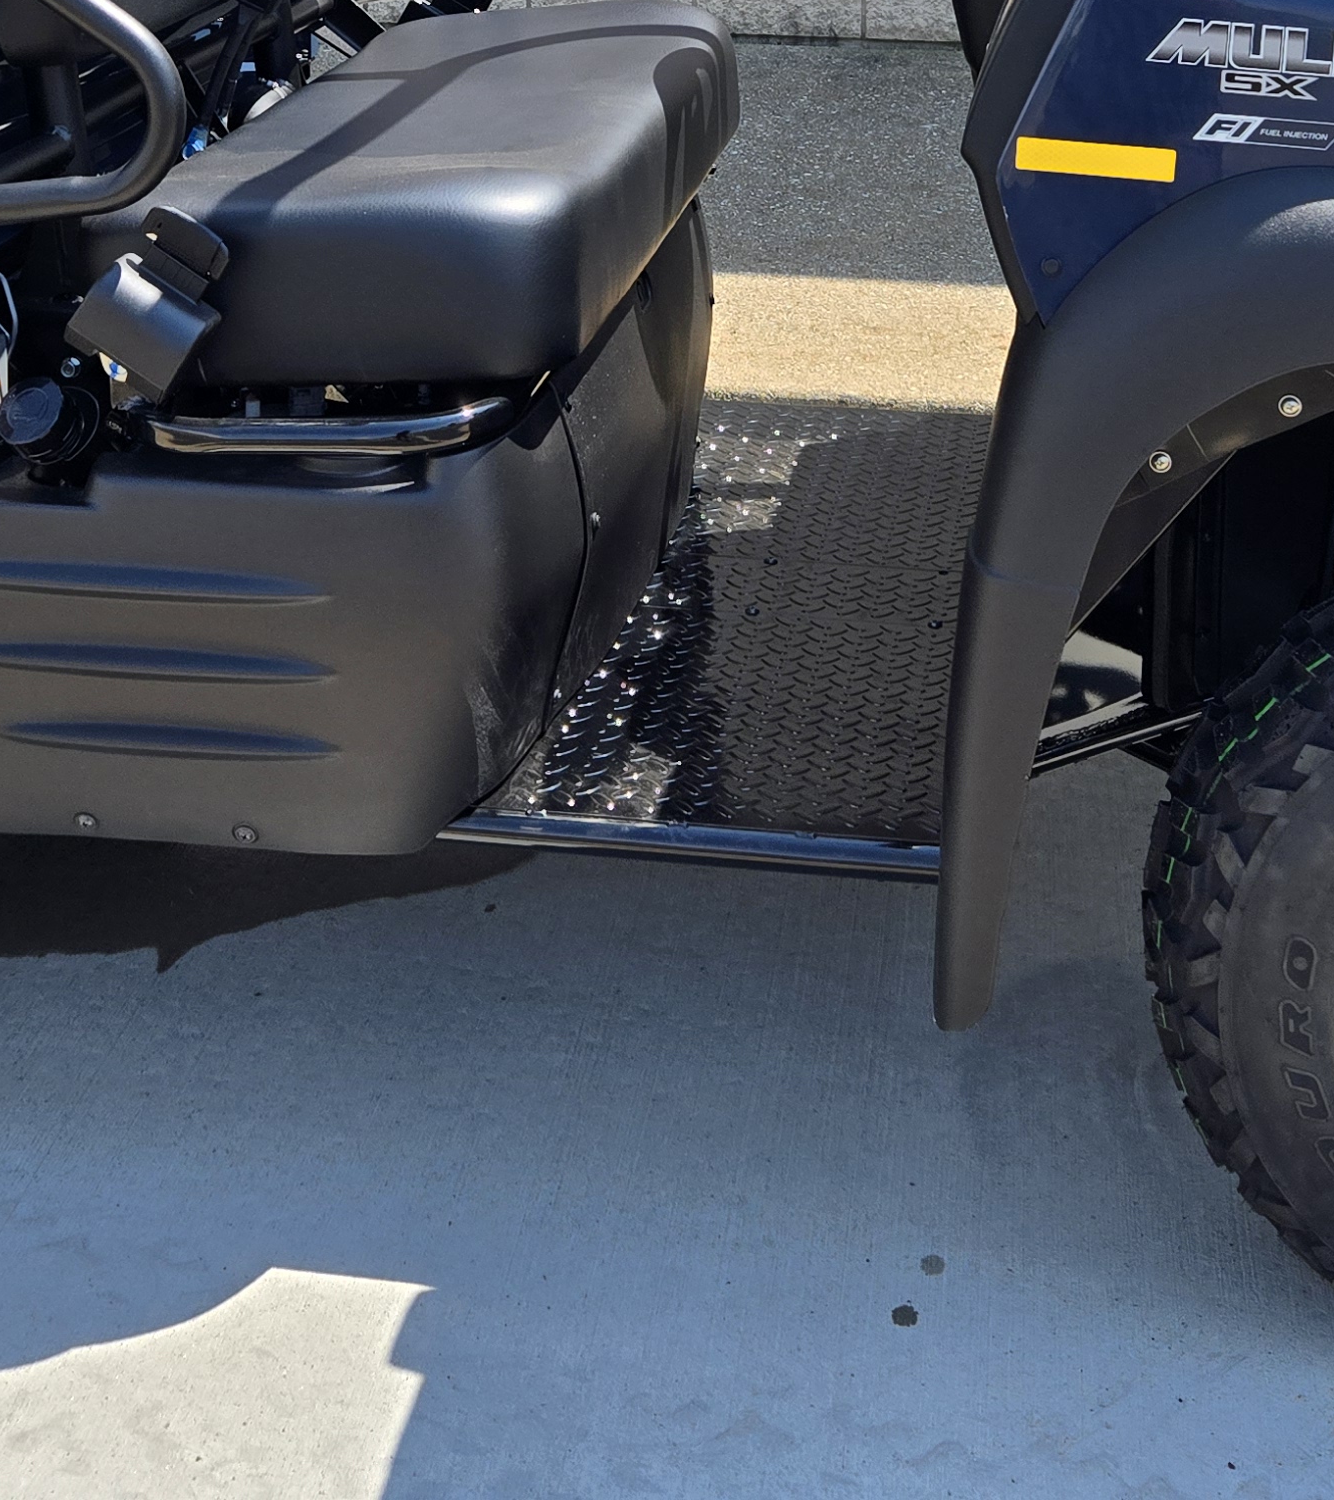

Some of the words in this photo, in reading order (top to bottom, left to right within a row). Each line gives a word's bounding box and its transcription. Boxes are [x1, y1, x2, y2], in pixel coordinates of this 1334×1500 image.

[1220, 70, 1318, 100] SX
[1260, 128, 1282, 138] FUEL
[1283, 129, 1329, 141] INJECTION
